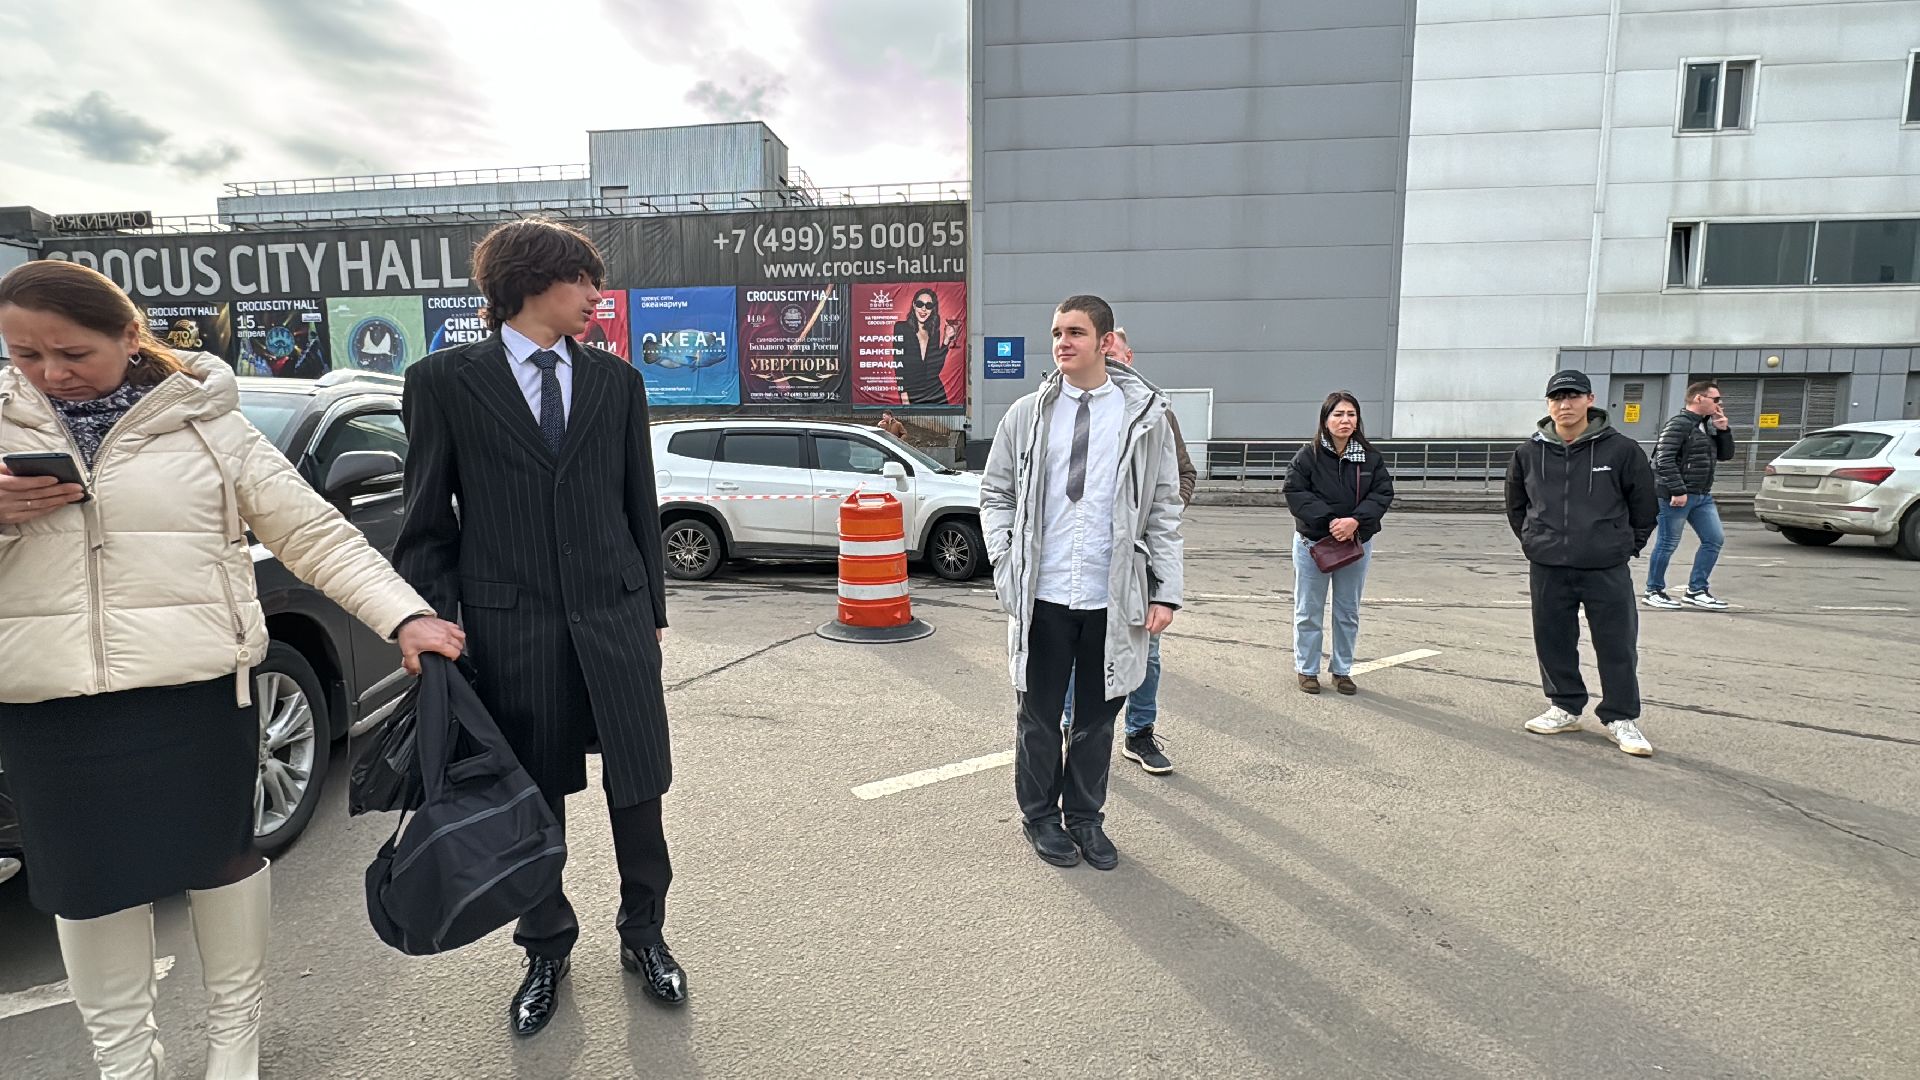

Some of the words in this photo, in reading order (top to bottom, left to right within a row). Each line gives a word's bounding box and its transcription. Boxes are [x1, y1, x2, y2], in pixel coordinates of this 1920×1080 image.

[50, 211, 148, 232] МЯКИНИНО
[713, 228, 746, 254] +7
[753, 222, 824, 257] (499)
[832, 224, 863, 250] 55
[870, 222, 924, 249] 000
[932, 221, 964, 247] 55
[47, 246, 221, 297] OCUS
[229, 242, 327, 295] CITY
[337, 237, 470, 291] HALL
[763, 254, 964, 279] www.crocus-hall.ru
[428, 296, 467, 309] CROCUS
[747, 291, 786, 302] CROCUS
[788, 290, 810, 301] CITY
[147, 307, 178, 317] CROCUS
[179, 306, 197, 316] CITY
[198, 306, 219, 316] HALL
[236, 301, 272, 312] CROCUS
[272, 300, 292, 311] CITY
[294, 299, 319, 310] HALL
[641, 301, 688, 309] океанариум
[236, 315, 256, 329] 15
[237, 330, 266, 339] апреля
[642, 332, 726, 347] ОКЕАН
[859, 335, 904, 343] КАРАОКЕ
[749, 343, 784, 351] Большого
[786, 344, 810, 353] театра
[812, 343, 839, 351] России
[750, 358, 839, 371] УВЕРТЮРЫ
[859, 361, 904, 369] ВЕРАНДА
[826, 392, 840, 400] 12+
